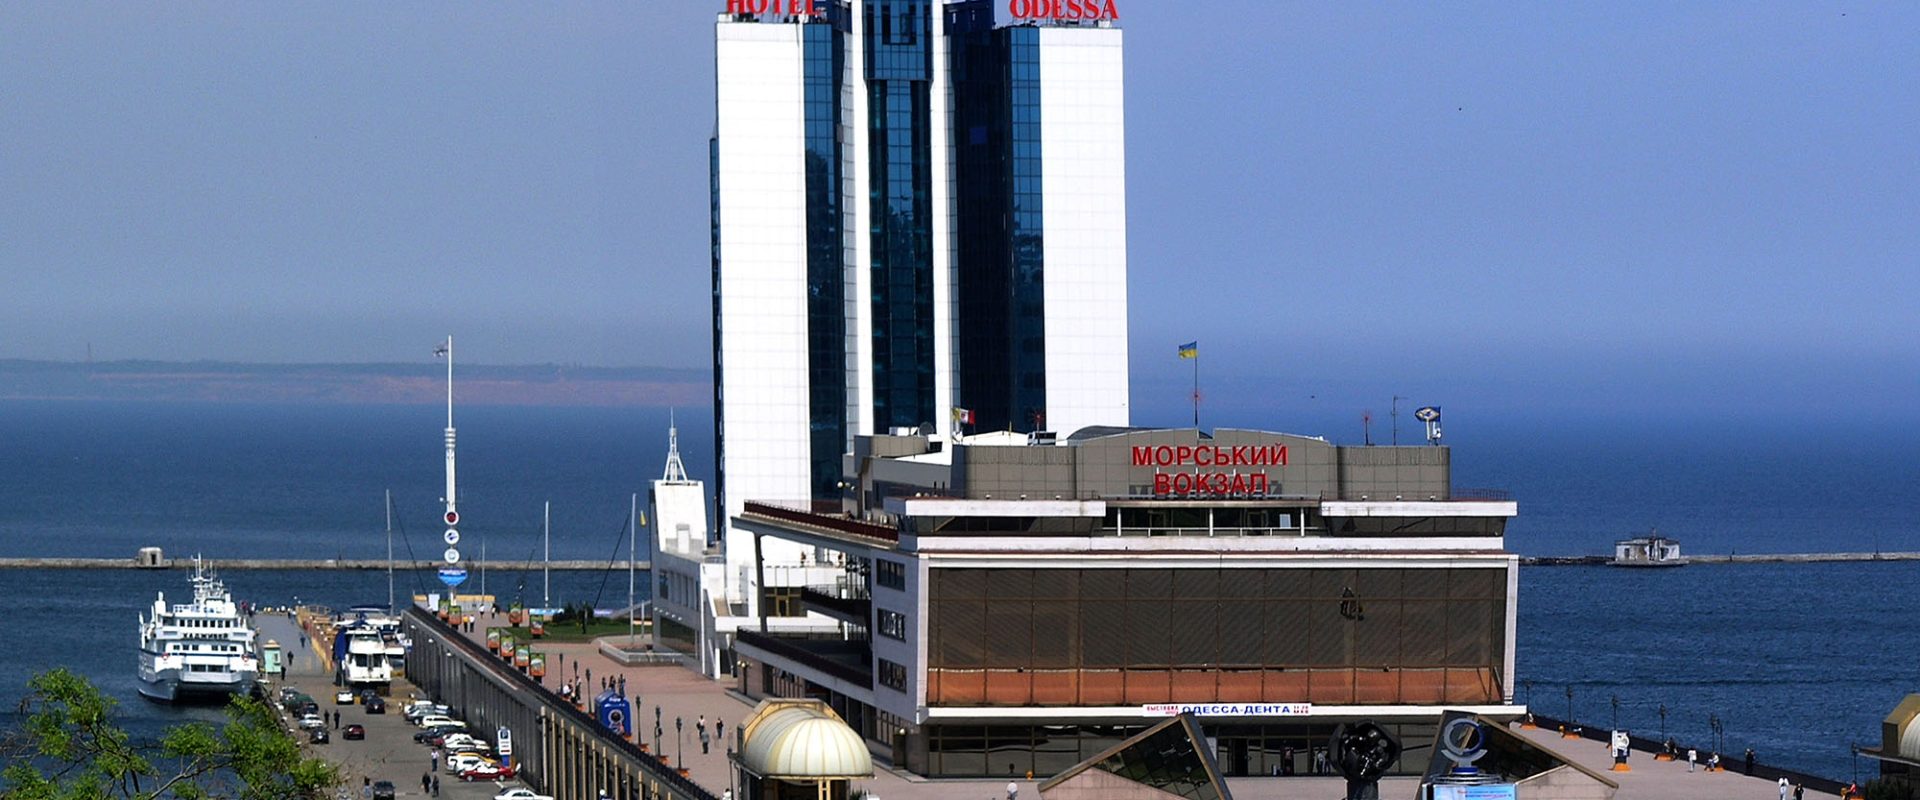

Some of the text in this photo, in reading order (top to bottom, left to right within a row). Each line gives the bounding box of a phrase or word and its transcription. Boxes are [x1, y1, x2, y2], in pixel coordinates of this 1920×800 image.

[726, 0, 818, 15] HOTEL
[1009, 0, 1119, 20] ODESSA
[1132, 443, 1288, 467] МОРСЬКИЙ
[1154, 473, 1268, 495] ВОКЗАЛ
